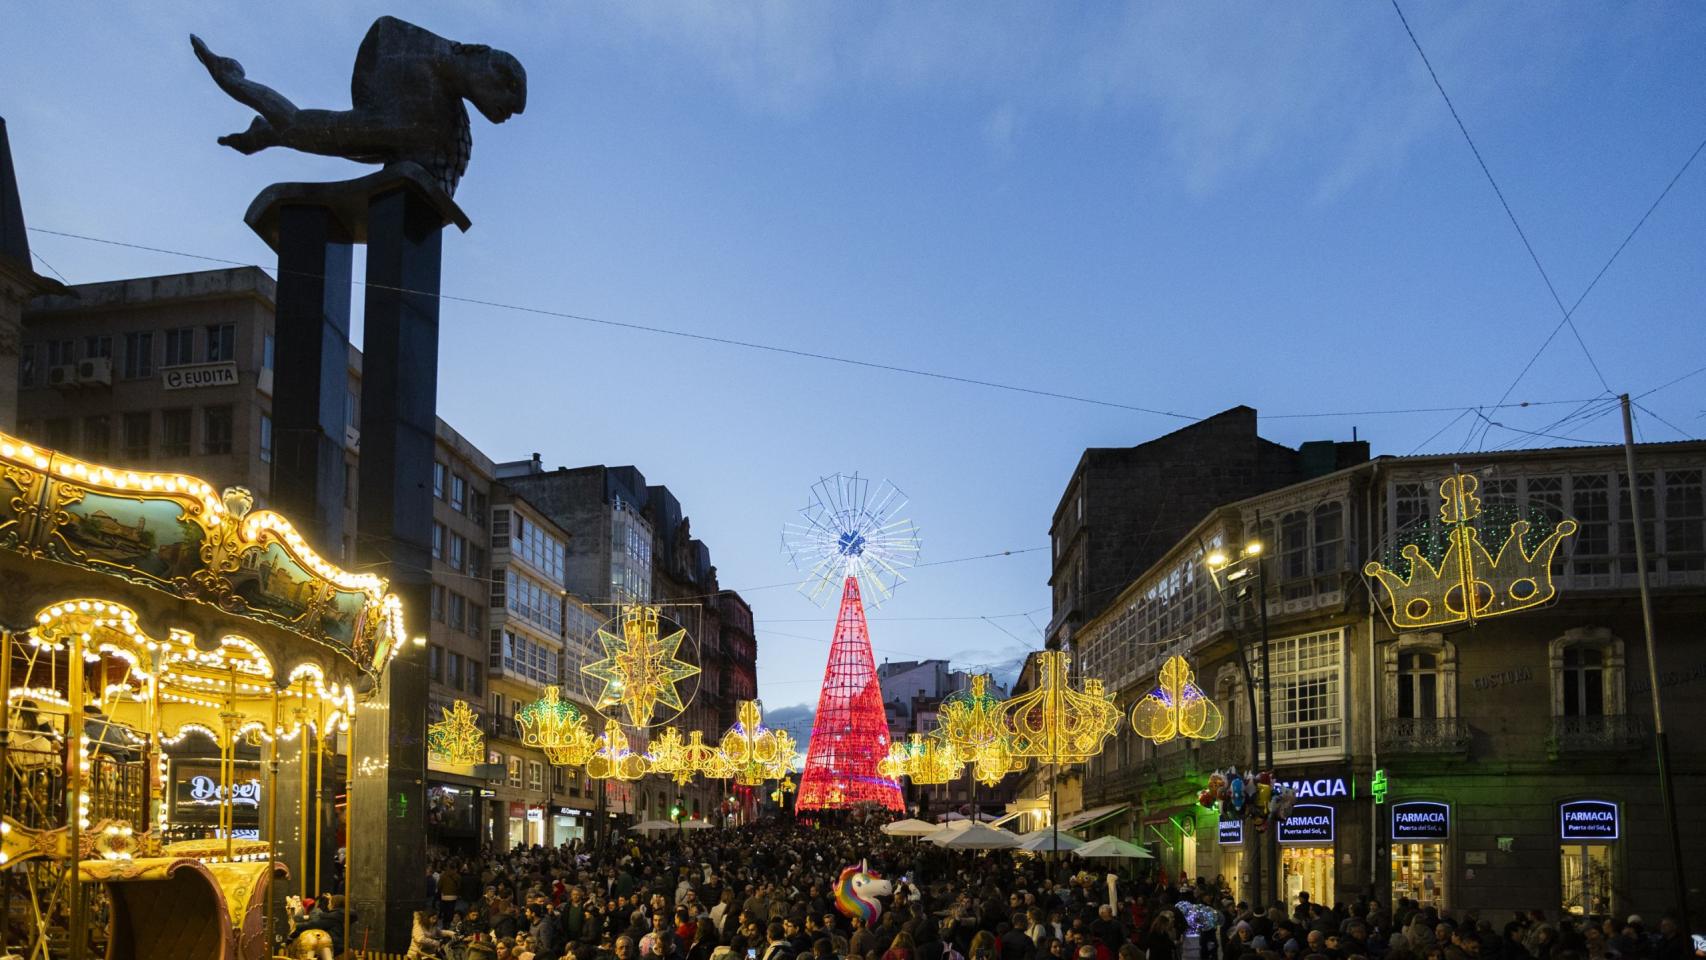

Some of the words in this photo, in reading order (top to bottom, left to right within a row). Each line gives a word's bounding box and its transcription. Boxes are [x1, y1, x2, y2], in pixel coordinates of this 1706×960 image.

[185, 369, 233, 384] EUDITA
[1396, 813, 1444, 822] FARMACIA
[1565, 812, 1613, 820] FARMACIA
[1281, 816, 1329, 826] ARMACIA
